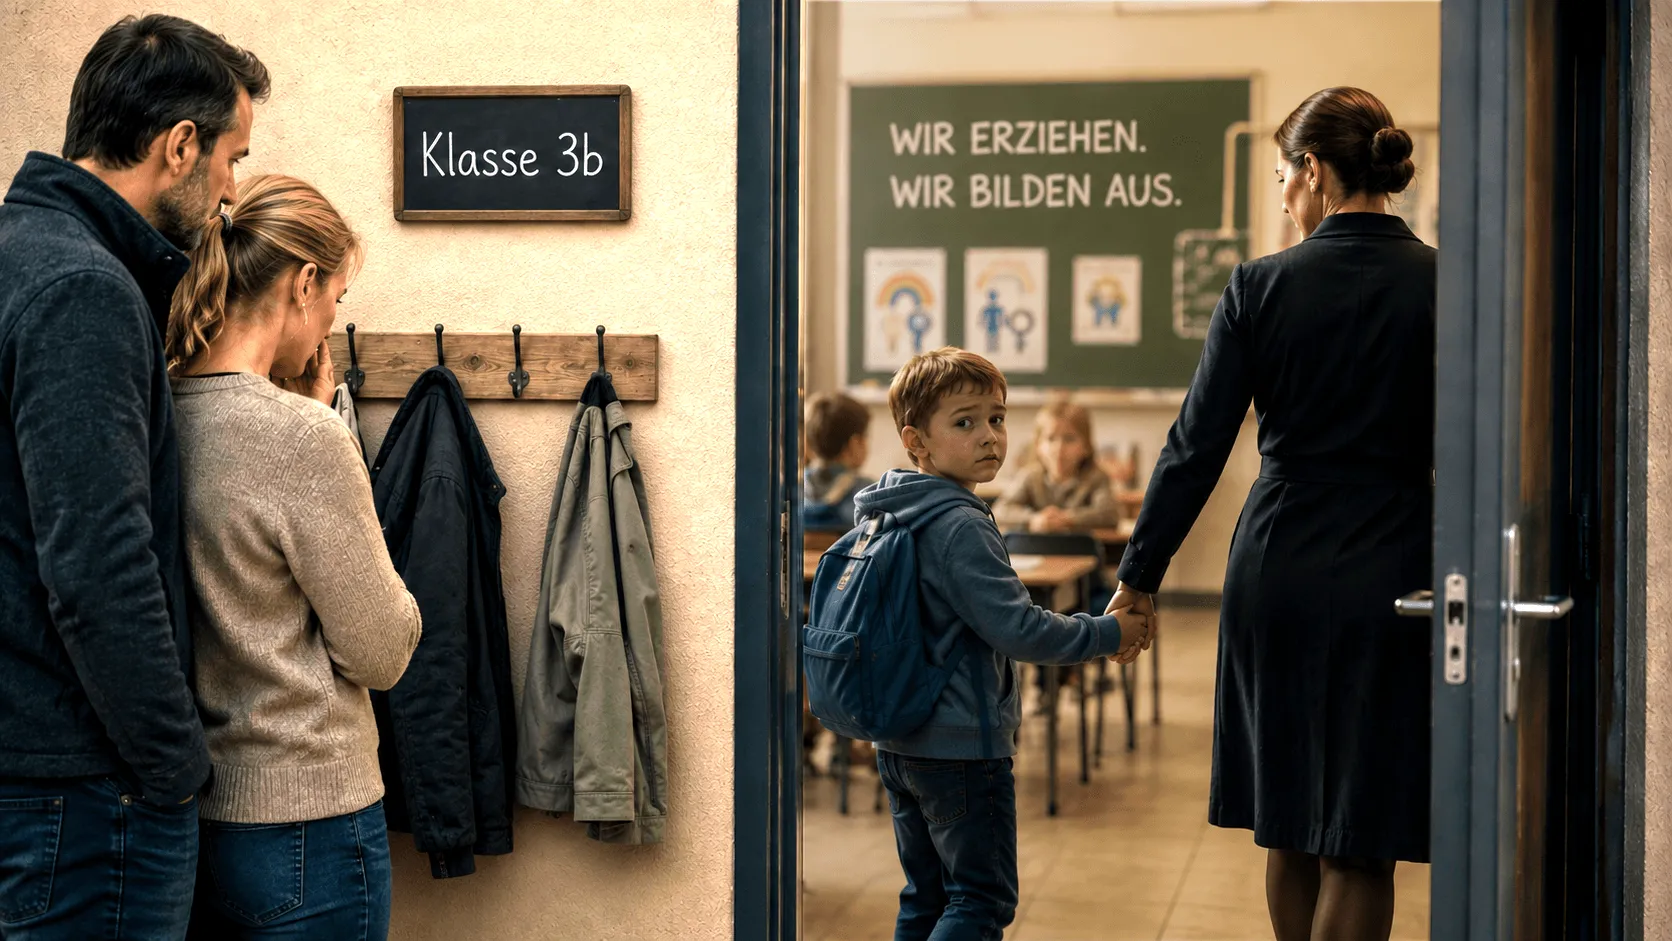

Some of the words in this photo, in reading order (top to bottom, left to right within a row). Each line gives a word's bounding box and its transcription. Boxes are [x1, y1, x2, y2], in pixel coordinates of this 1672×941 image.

[422, 130, 540, 177] Klasse
[556, 131, 604, 177] 3b
[889, 121, 956, 156] WIR
[970, 119, 1147, 156] ERZIEHEN.
[889, 173, 956, 209] WIR
[969, 173, 1091, 209] BILDEN
[1105, 173, 1183, 208] AUS.
